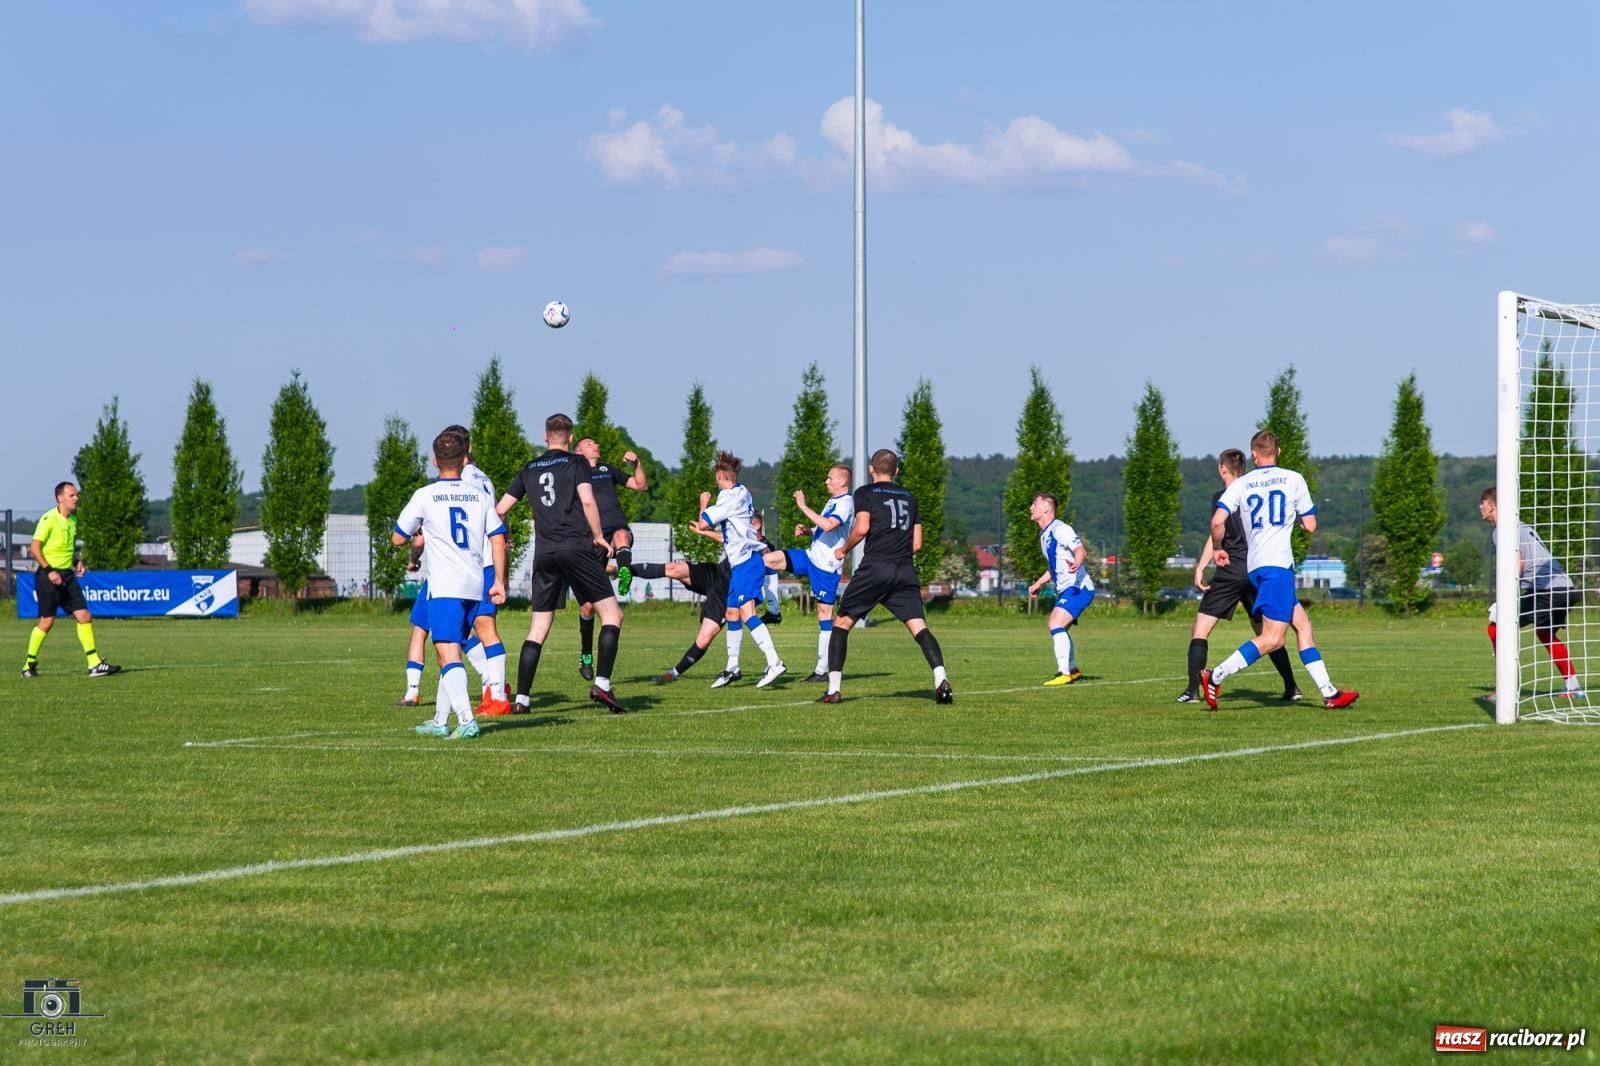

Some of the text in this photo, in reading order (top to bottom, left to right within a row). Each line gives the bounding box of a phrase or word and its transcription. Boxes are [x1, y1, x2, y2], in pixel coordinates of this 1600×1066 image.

[432, 494, 450, 503] UNIA
[538, 471, 556, 507] 3
[883, 498, 910, 531] 15
[1246, 489, 1286, 530] 20
[449, 506, 471, 551] 6
[82, 585, 170, 601] iaraciborz.eu
